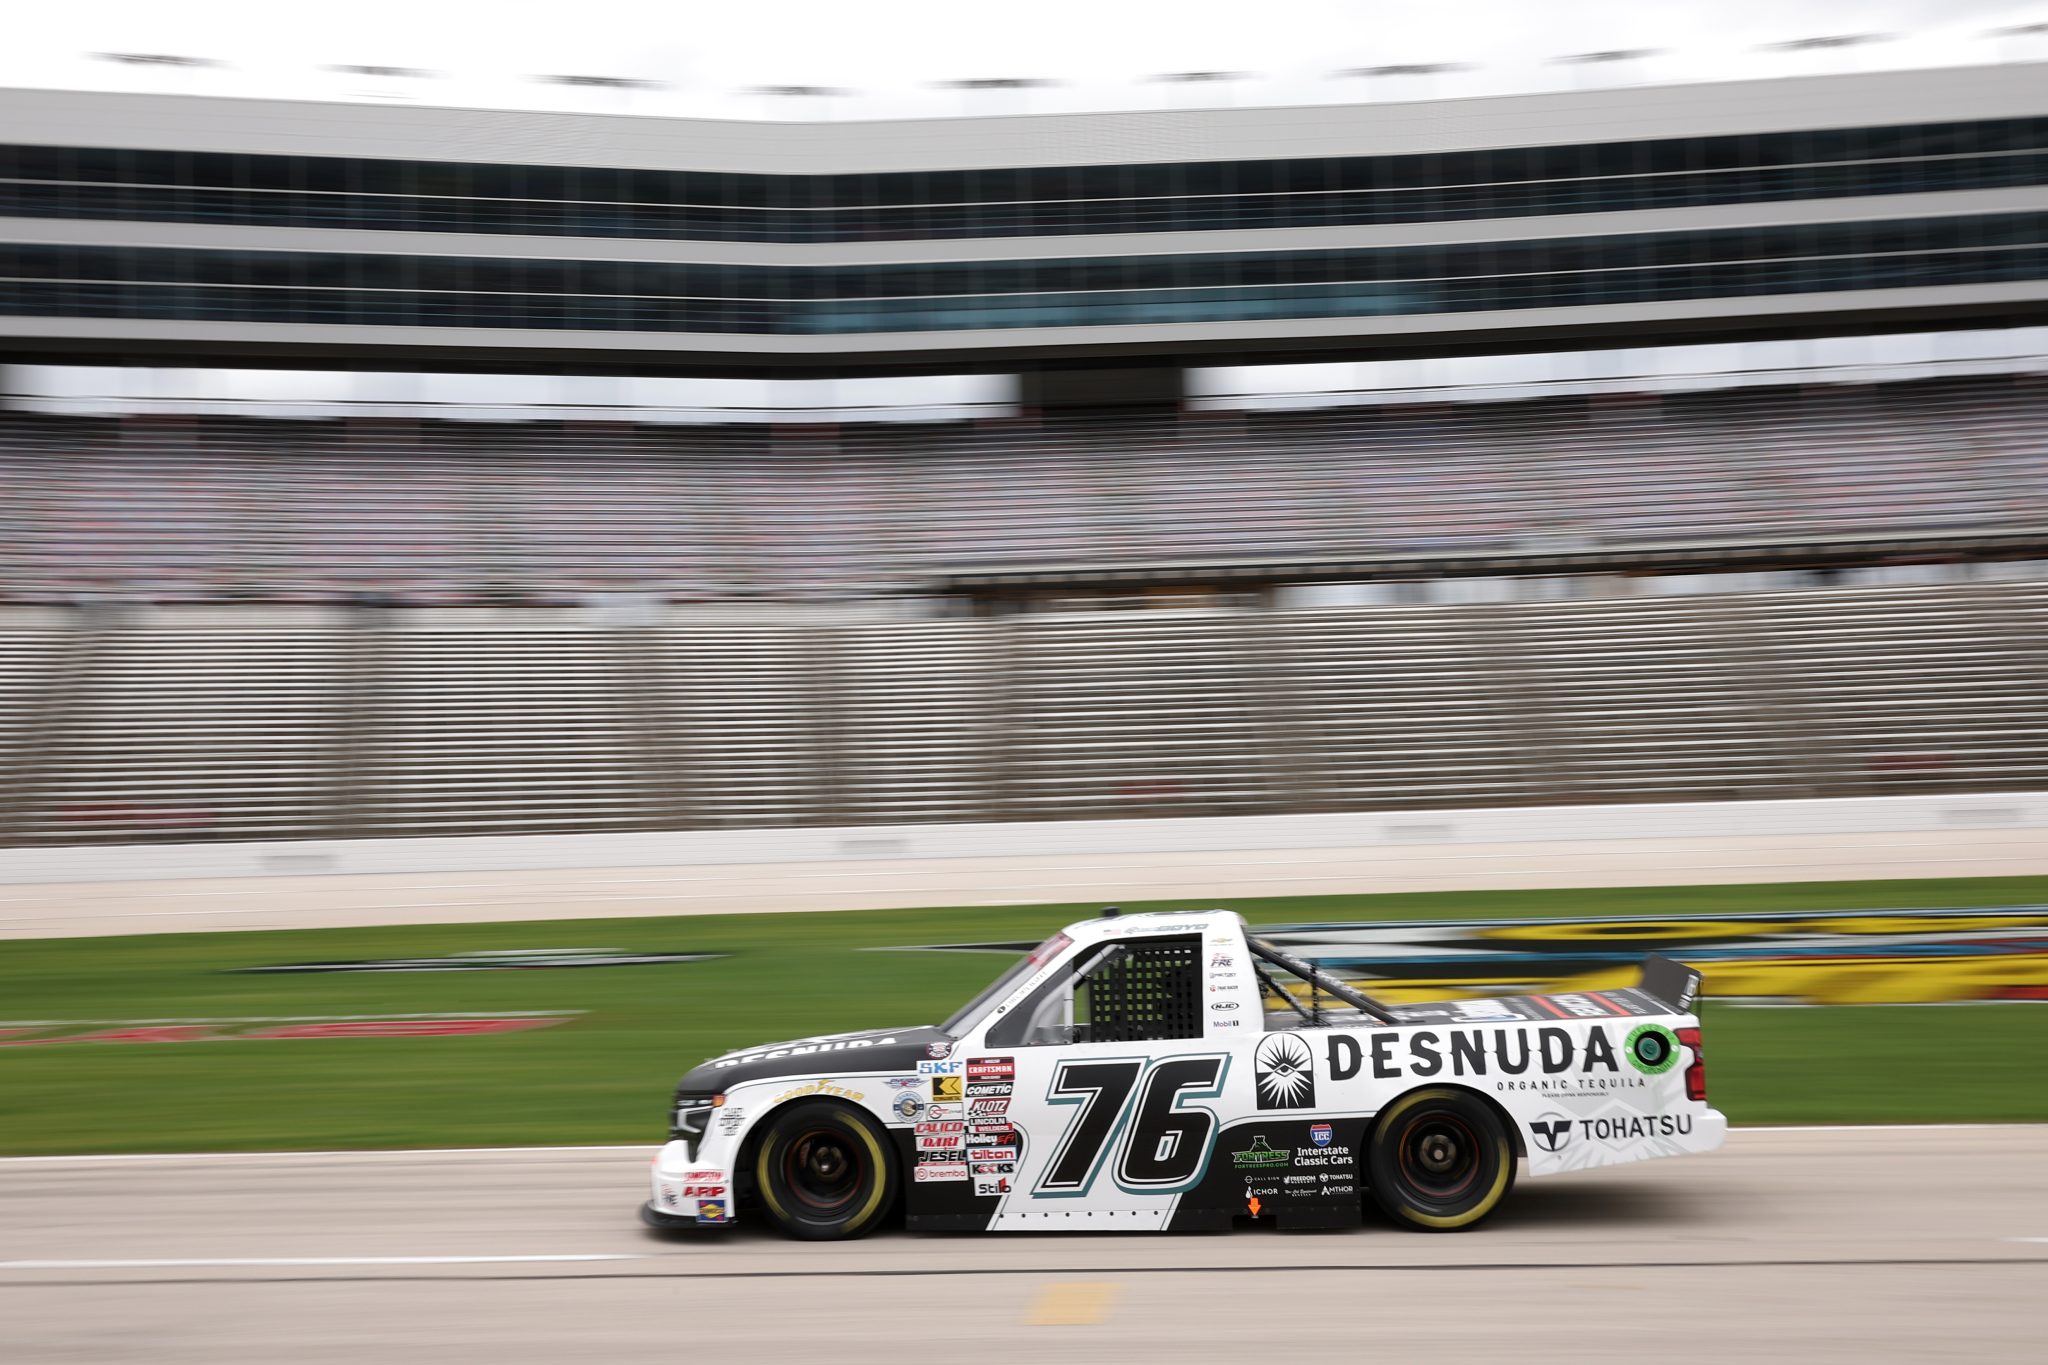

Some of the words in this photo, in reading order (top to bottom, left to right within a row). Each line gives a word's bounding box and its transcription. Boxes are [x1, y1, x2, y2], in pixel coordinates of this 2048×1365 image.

[1326, 1026, 1620, 1081] DESNUDA
[920, 1062, 962, 1074] SKF
[968, 1065, 1013, 1074] CRAFTSMAN
[966, 1084, 1012, 1096] COMETIC
[1496, 1079, 1568, 1092] ORGANIC
[1578, 1078, 1646, 1090] TEQUILA
[973, 1101, 1008, 1113] KLOTZ
[915, 1122, 965, 1134] CALICO
[970, 1118, 1006, 1126] LINCOLN
[977, 1124, 1010, 1132] WELDERS
[1029, 1052, 1233, 1199] 76
[1579, 1113, 1693, 1141] TOHATSU
[966, 1134, 997, 1146] Holley
[1314, 1131, 1330, 1141] ICC
[920, 1150, 966, 1161] JESEL
[970, 1149, 1014, 1160] tilton
[1235, 1150, 1288, 1162] FORTRESS
[1297, 1146, 1349, 1157] Interstate
[1294, 1156, 1329, 1167] Classic
[1330, 1155, 1354, 1166] Cars
[929, 1168, 966, 1178] brembo
[1329, 1173, 1354, 1181] TOHATSU
[978, 1178, 1012, 1194] Stilo
[1253, 1188, 1278, 1196] ICHOR
